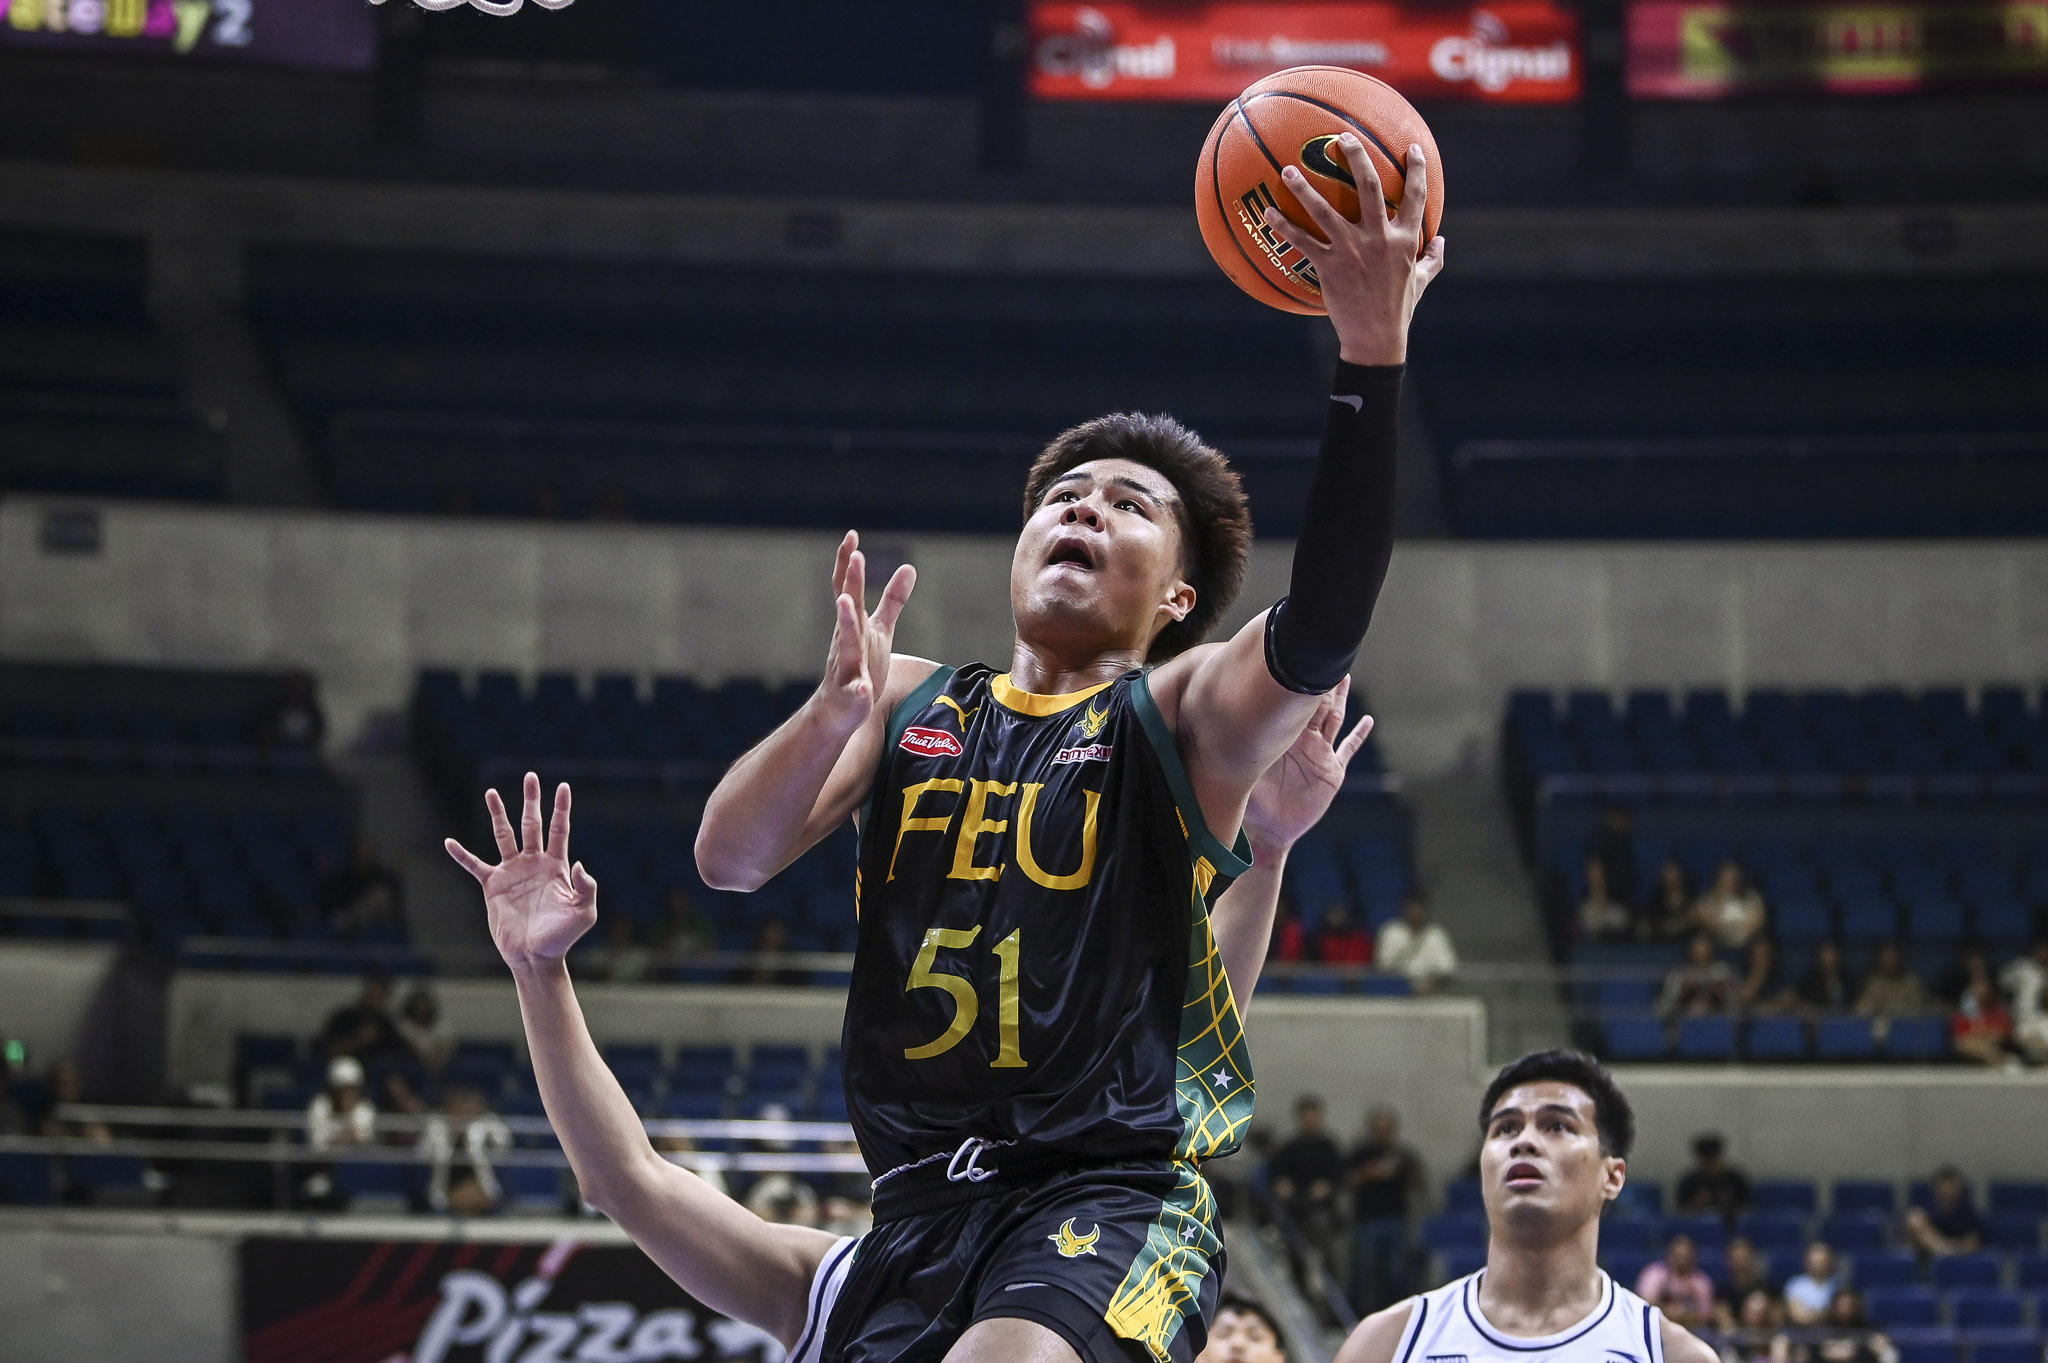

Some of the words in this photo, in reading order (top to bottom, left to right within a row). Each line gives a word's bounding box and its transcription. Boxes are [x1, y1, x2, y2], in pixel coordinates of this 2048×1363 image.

[1430, 14, 1569, 91] Cignal
[886, 777, 1101, 890] FEU
[904, 924, 1028, 1067] 51
[414, 1269, 703, 1363] Pizza
